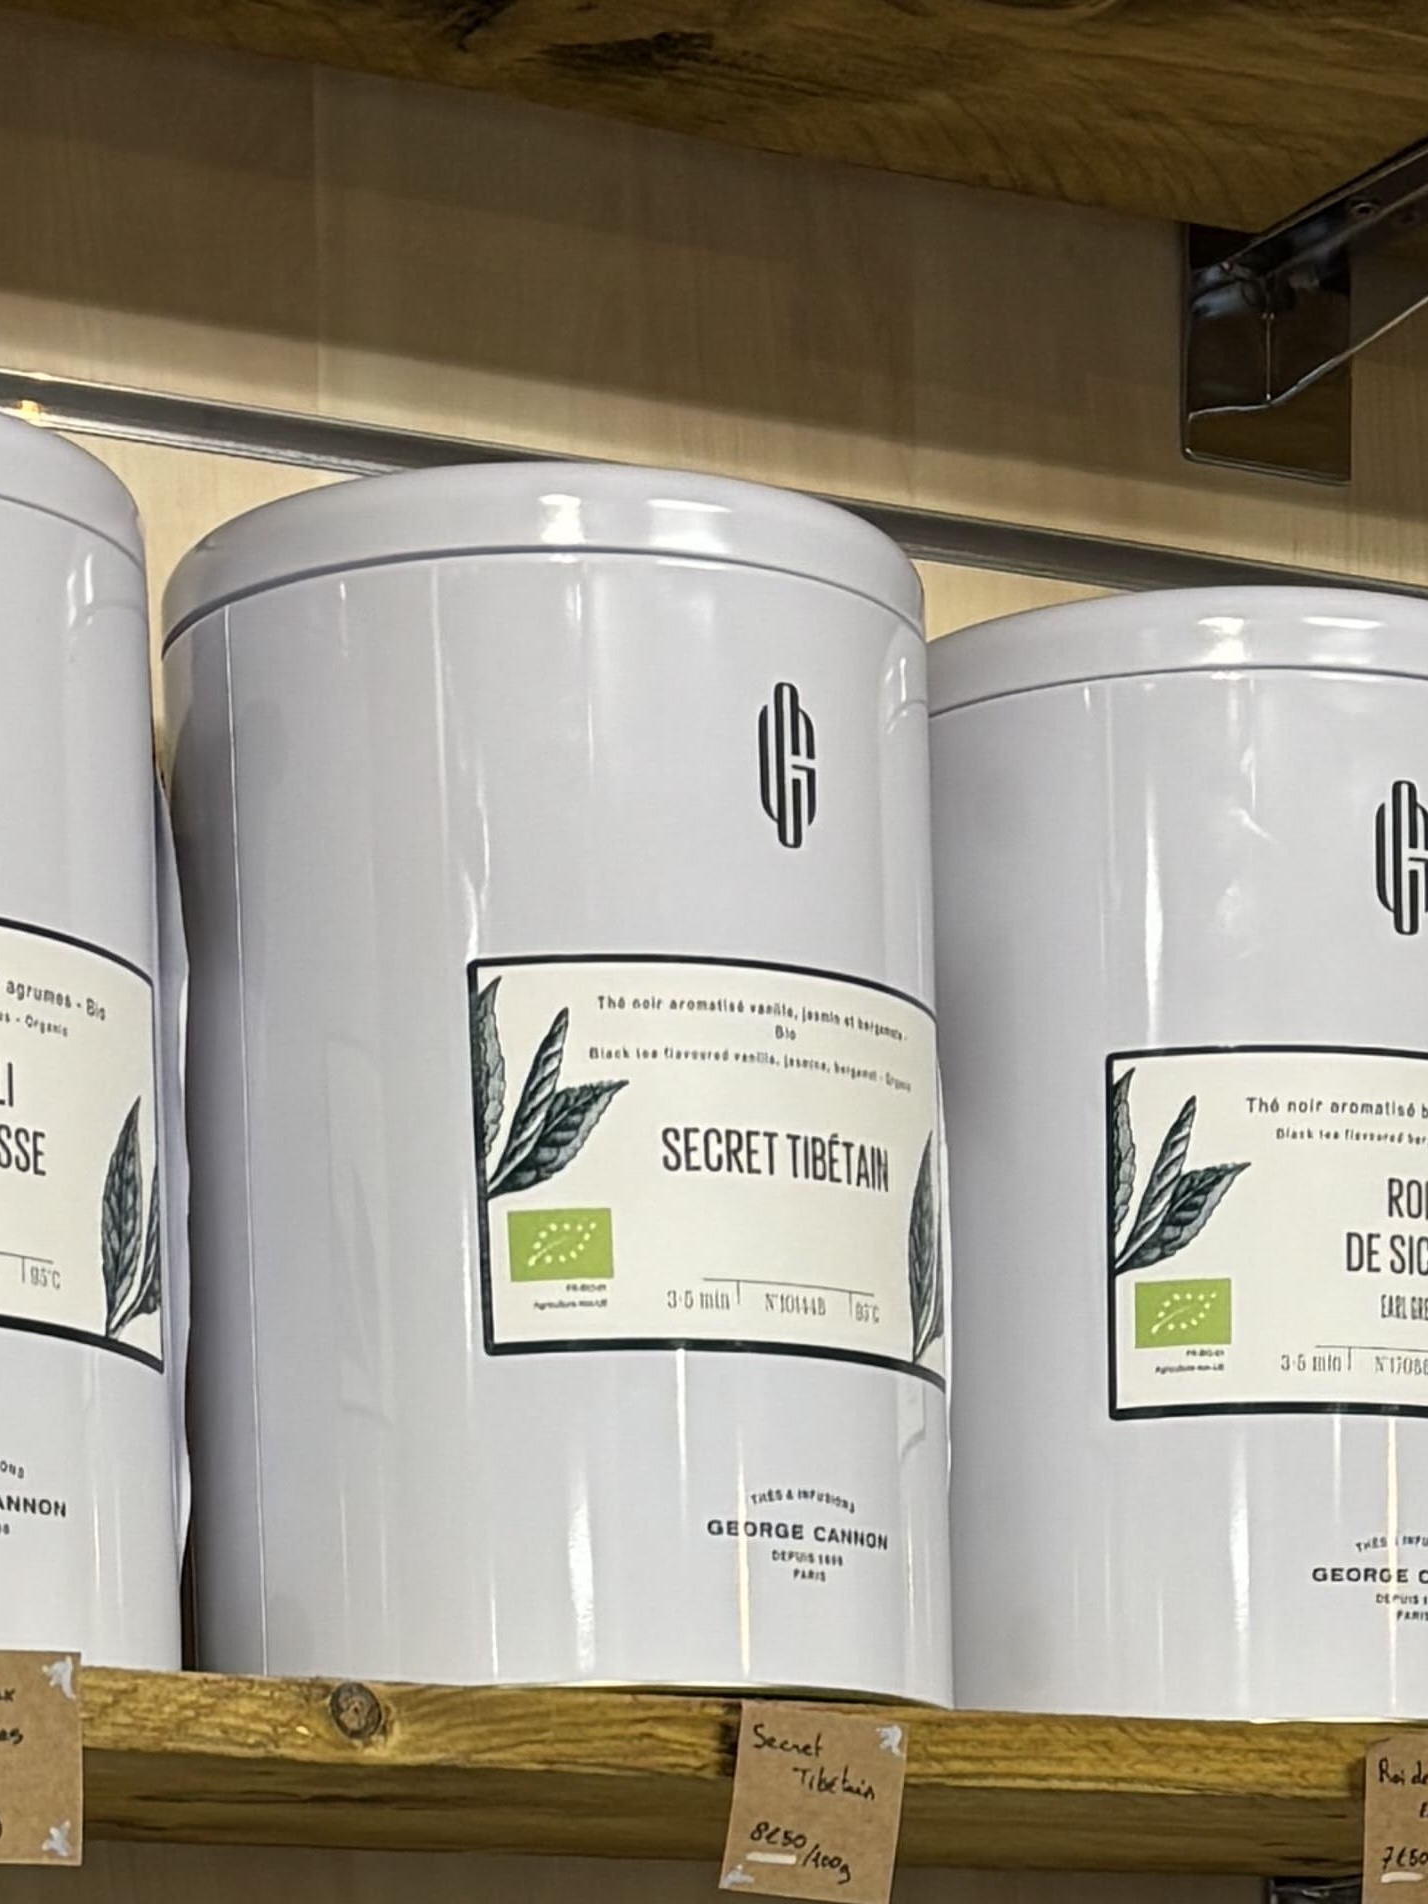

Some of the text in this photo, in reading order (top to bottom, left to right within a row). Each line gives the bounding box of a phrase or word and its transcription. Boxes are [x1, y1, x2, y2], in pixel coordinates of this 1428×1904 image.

[6, 981, 71, 1008] agrumes
[86, 998, 105, 1021] Bio
[1246, 1097, 1279, 1112] Thé
[1288, 1099, 1322, 1113] noir
[662, 1128, 888, 1192] SECRET TIBÉTAIN
[1347, 1232, 1381, 1272] DE
[1381, 1294, 1407, 1319] EARL
[707, 1520, 888, 1550] GEORGE CANNON
[1312, 1568, 1408, 1583] GEORGE
[753, 1723, 822, 1757] Secret
